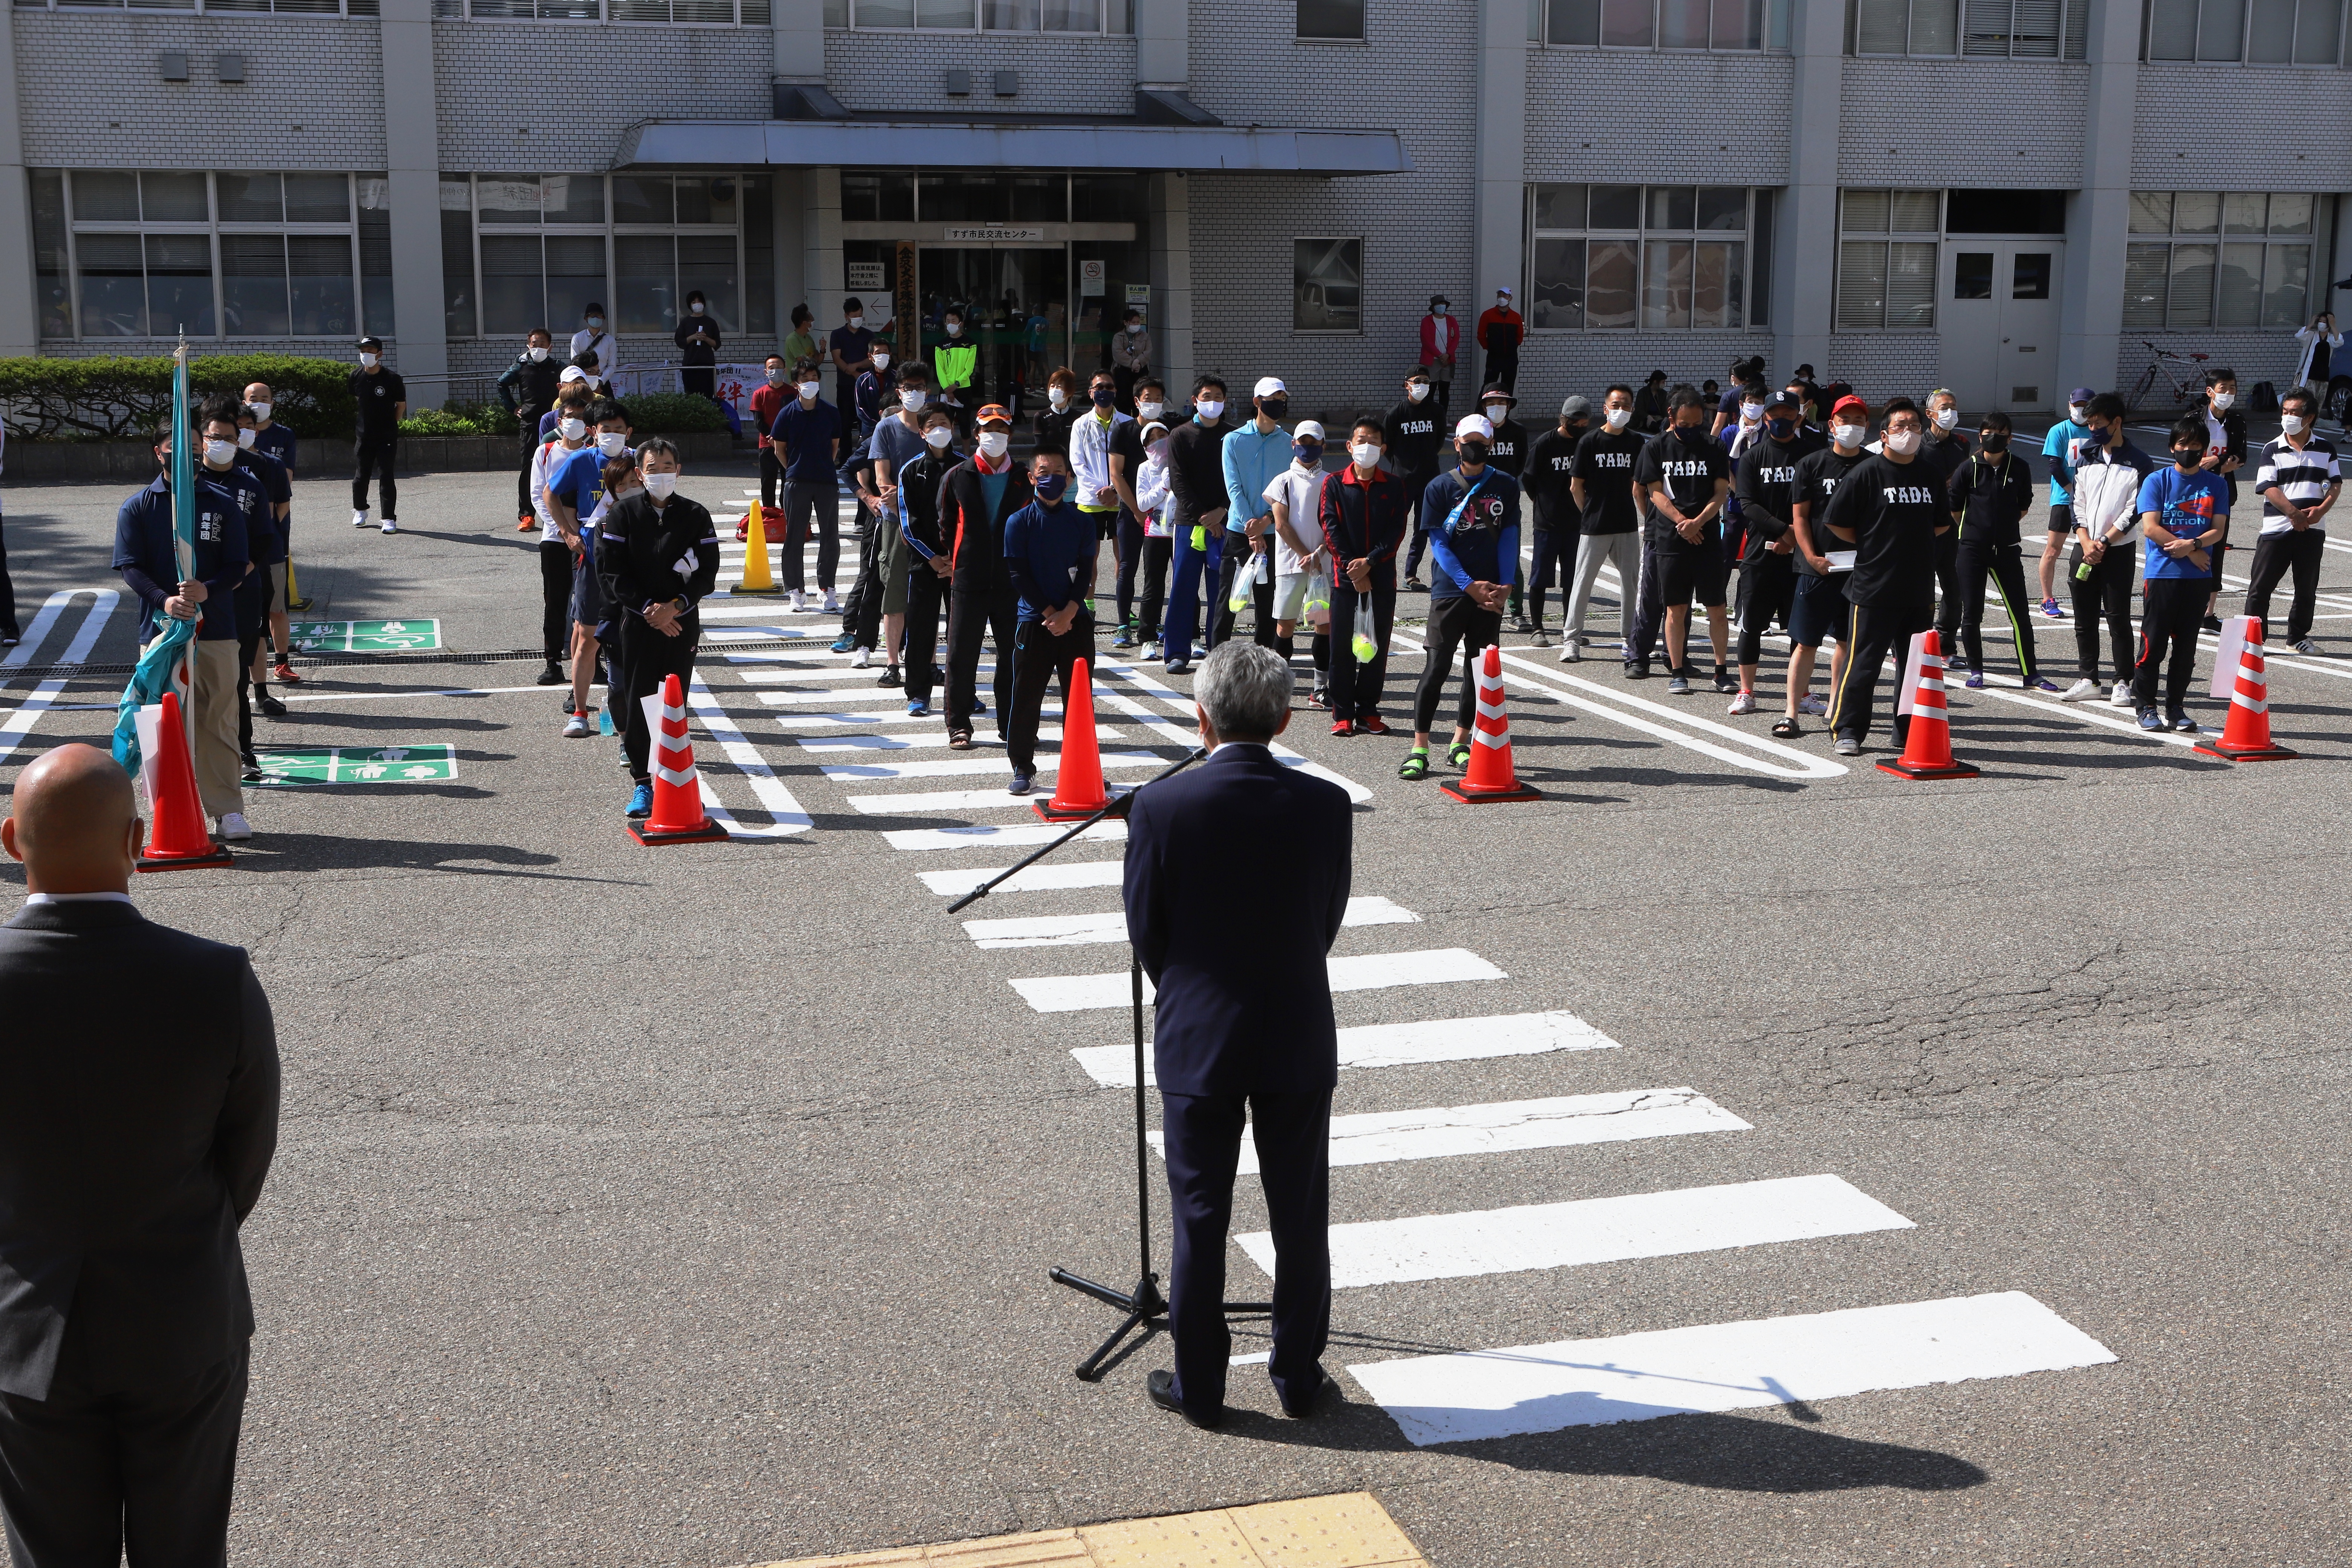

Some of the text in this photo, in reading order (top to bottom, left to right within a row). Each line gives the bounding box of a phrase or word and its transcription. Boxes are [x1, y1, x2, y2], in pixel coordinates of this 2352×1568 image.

[952, 230, 1036, 238] すず市民交流センター
[898, 247, 914, 357] 金沢大学珠洲サテライト
[1401, 420, 1433, 434] TADA
[1596, 453, 1631, 468] TADA
[1662, 460, 1707, 476] TADA
[1883, 487, 1932, 504] TADA
[200, 512, 211, 540] 青年団
